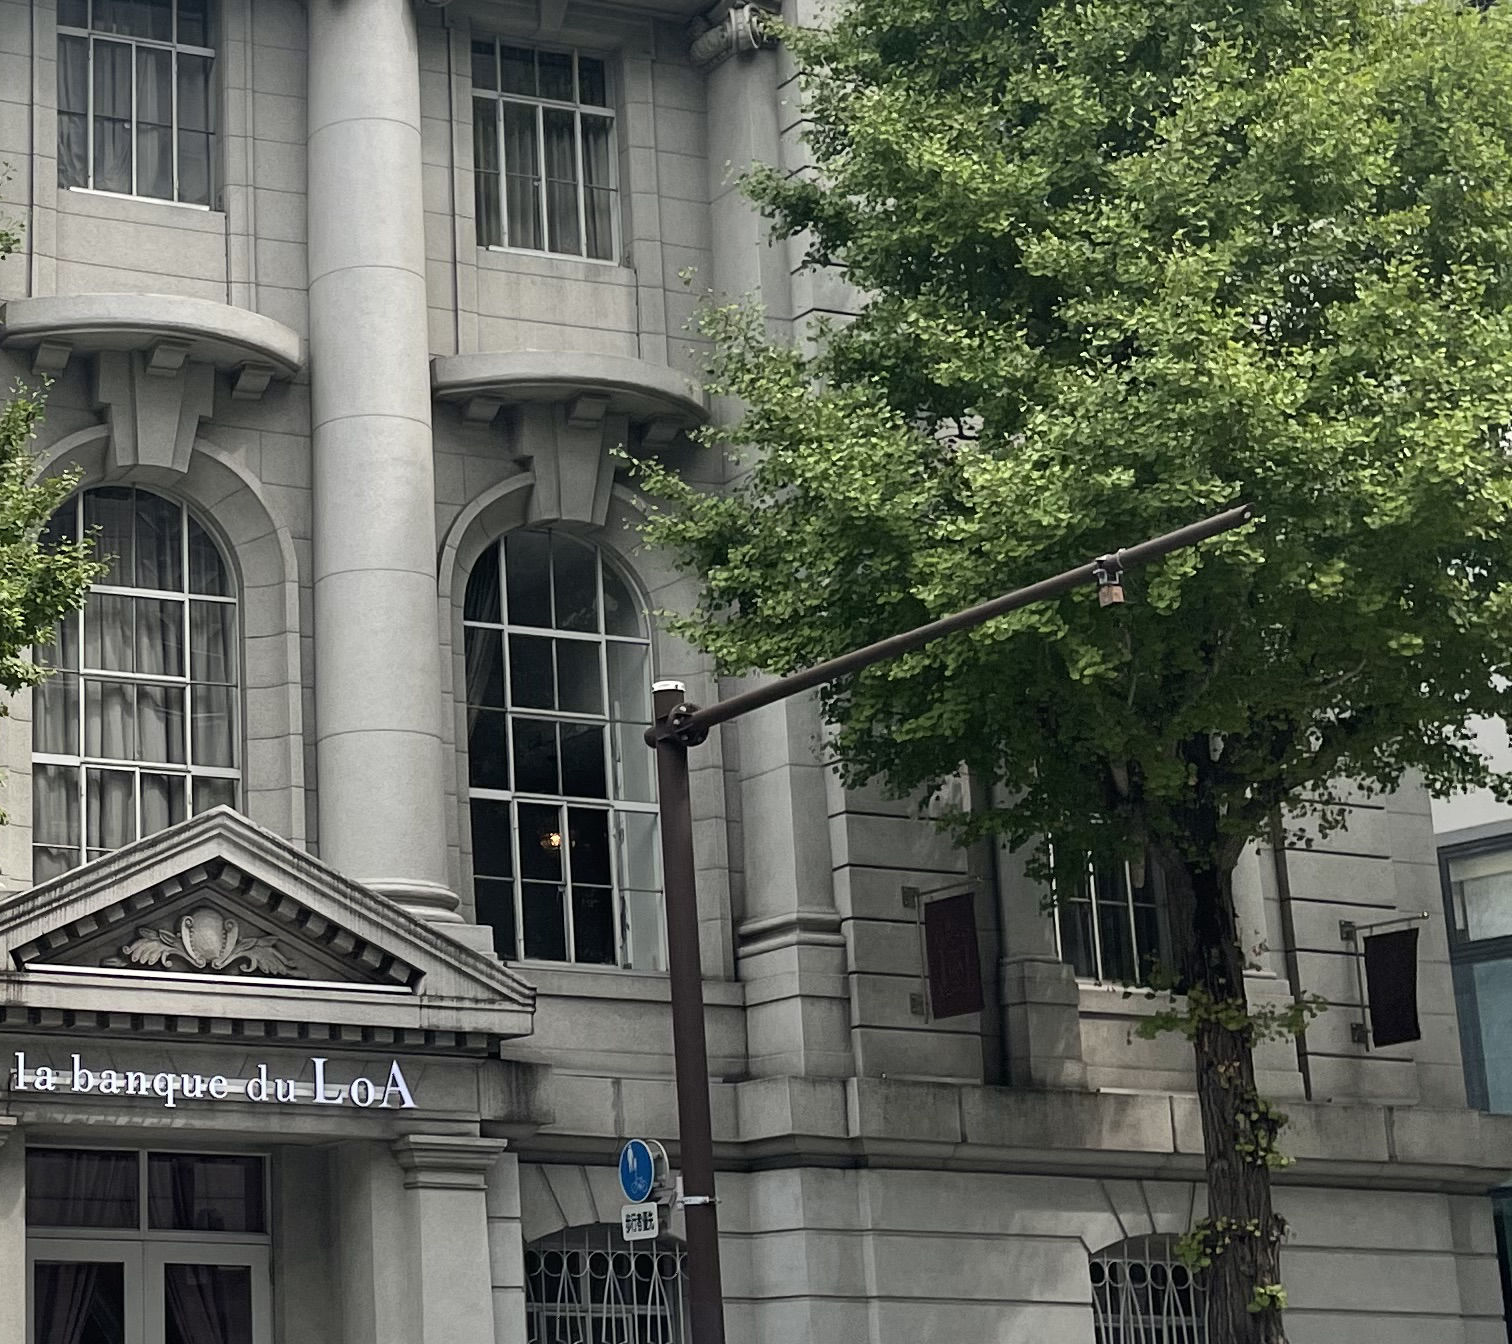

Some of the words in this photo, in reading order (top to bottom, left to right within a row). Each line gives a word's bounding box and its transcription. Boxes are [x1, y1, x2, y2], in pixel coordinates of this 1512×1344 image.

[14, 1052, 56, 1091] la
[71, 1053, 228, 1108] banque
[246, 1064, 297, 1103] du
[310, 1057, 418, 1109] LoA
